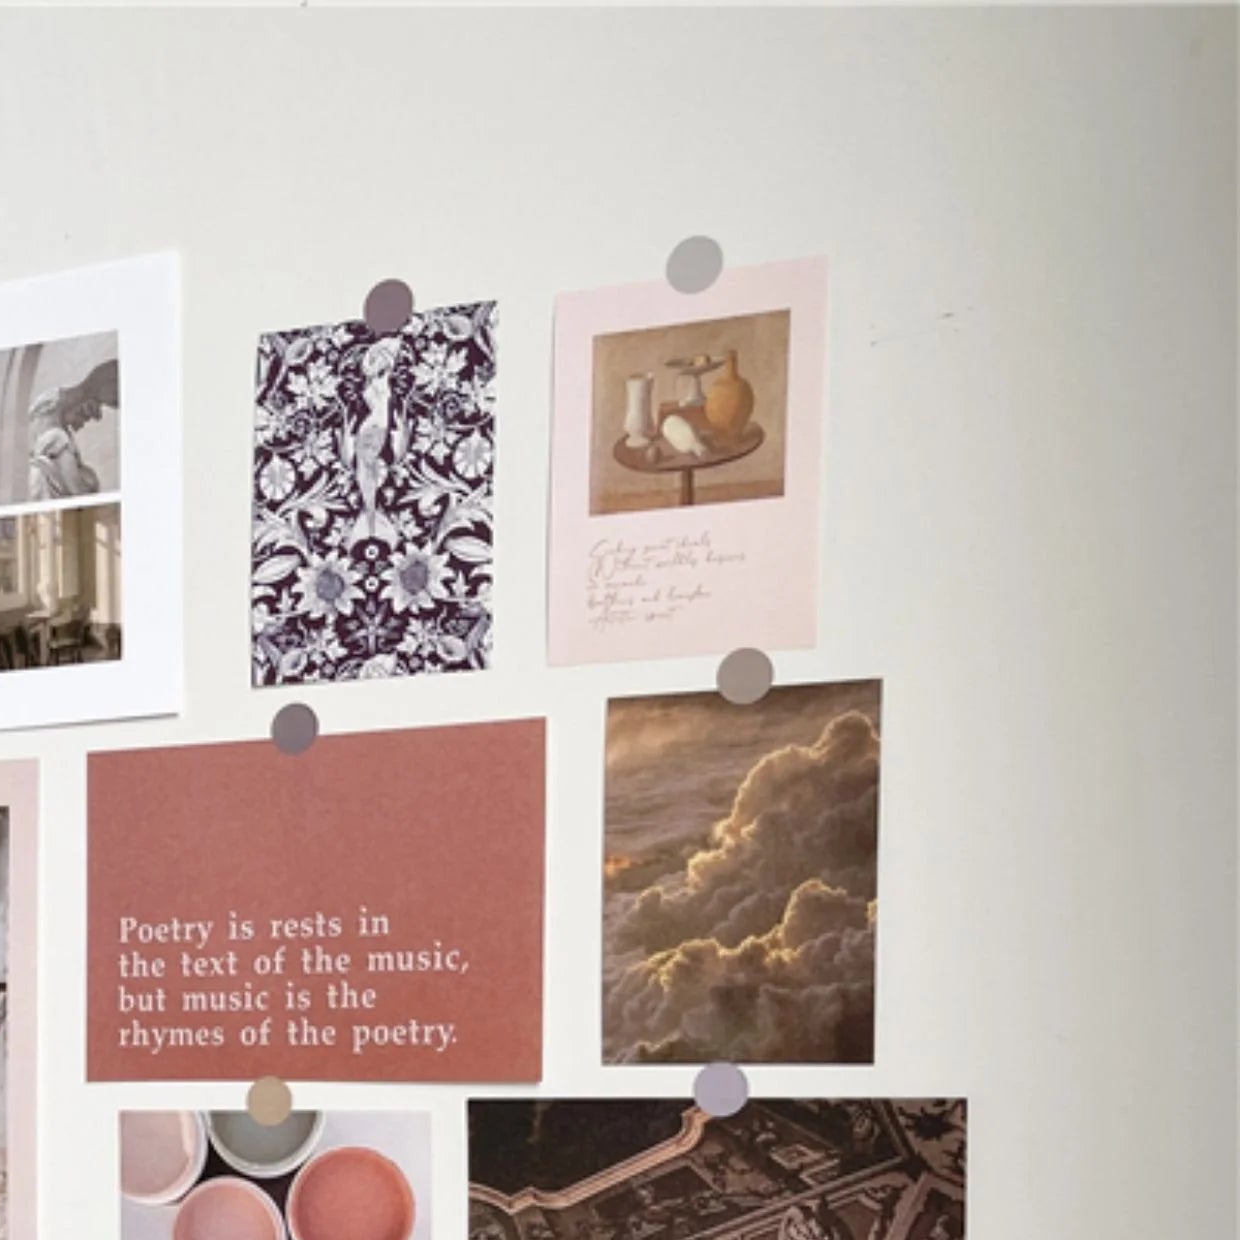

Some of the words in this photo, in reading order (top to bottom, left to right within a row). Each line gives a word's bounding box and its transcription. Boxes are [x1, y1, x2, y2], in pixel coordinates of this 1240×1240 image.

[118, 914, 213, 949] Poetry
[228, 910, 255, 941] is
[268, 910, 344, 940] rests
[358, 904, 390, 937] in
[118, 950, 166, 979] the
[180, 950, 240, 977] text
[252, 945, 287, 976] of
[300, 944, 352, 975] the
[366, 939, 471, 975] music,
[118, 984, 166, 1013] but
[180, 981, 270, 1012] music
[285, 981, 312, 1011] is
[326, 979, 378, 1009] the
[118, 1019, 226, 1055] rhymes
[238, 1015, 274, 1047] of
[285, 1015, 337, 1046] the
[351, 1017, 458, 1055] poetry.
